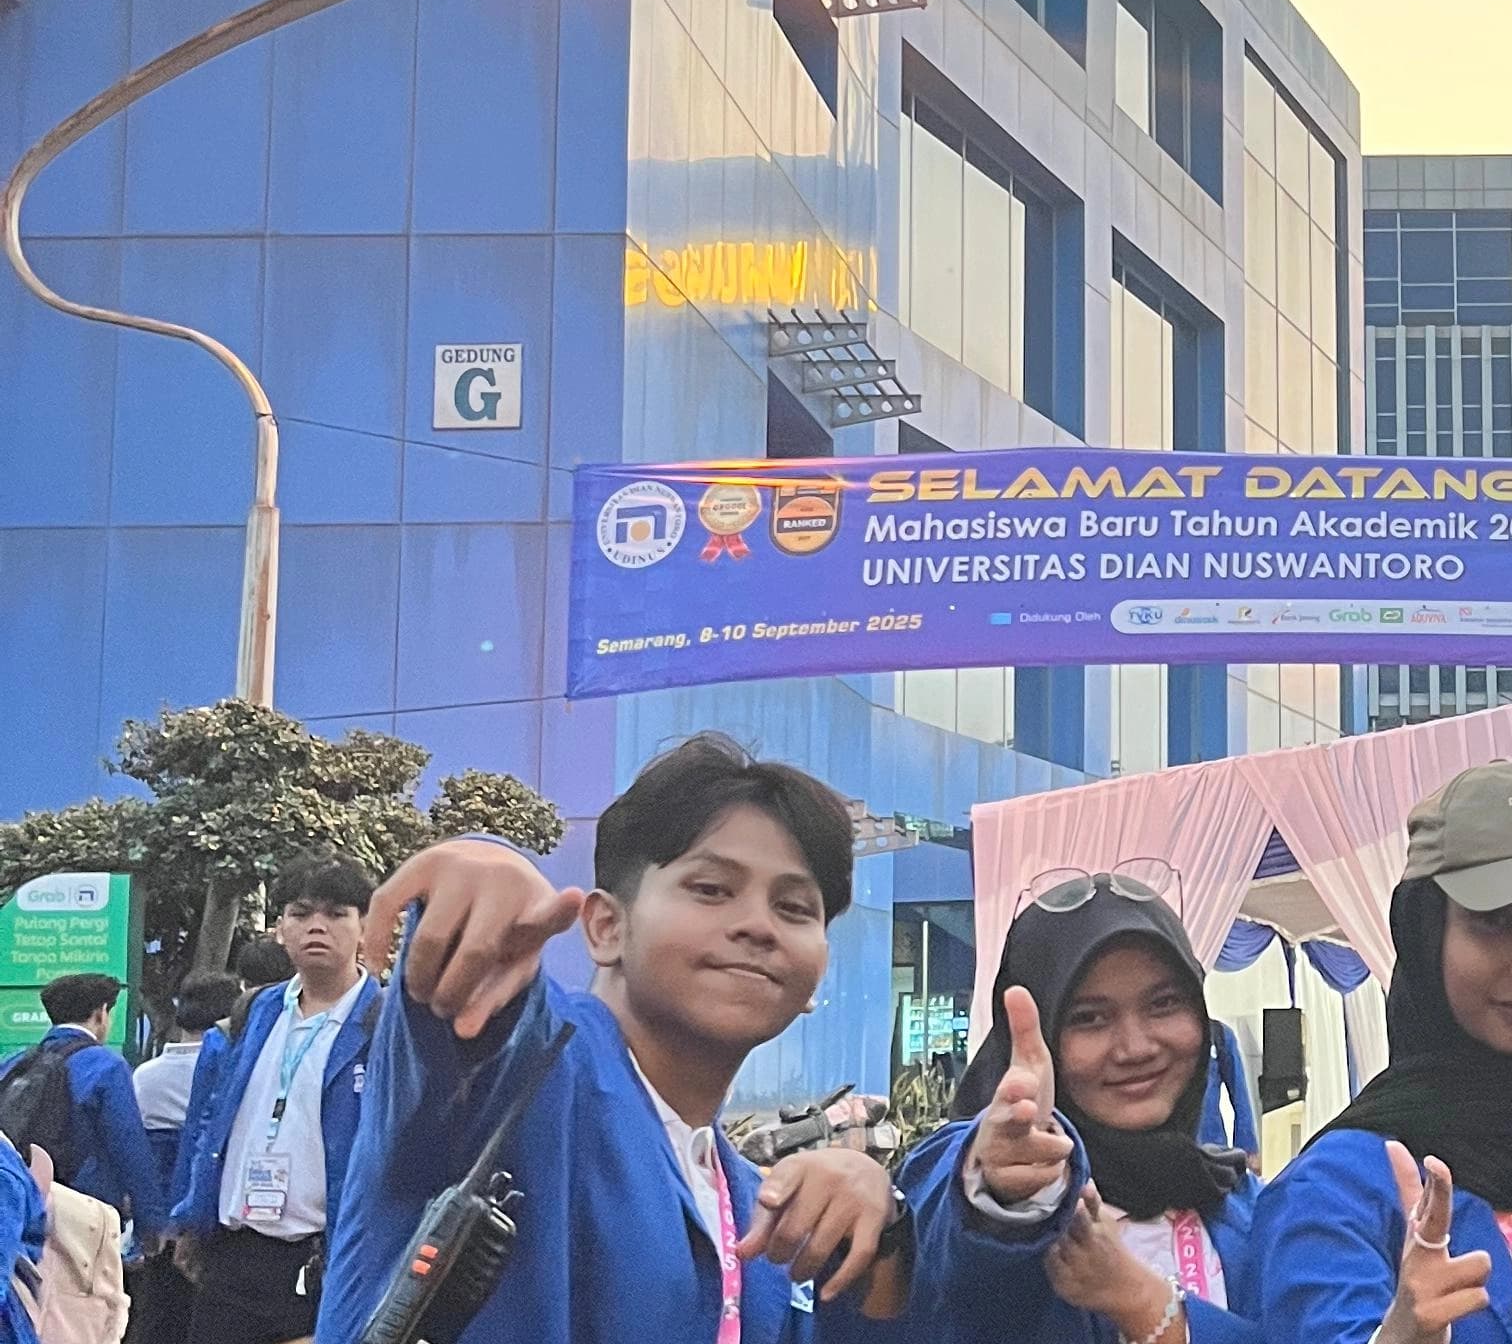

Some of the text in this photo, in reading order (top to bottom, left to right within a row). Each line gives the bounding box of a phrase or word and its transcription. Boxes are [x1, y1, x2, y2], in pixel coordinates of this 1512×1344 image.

[441, 347, 515, 364] GEDUNG
[454, 367, 502, 421] G
[866, 466, 1223, 503] SELAMAT
[783, 518, 826, 529] RANKED
[864, 510, 1067, 543] Mahasiswa
[1079, 510, 1158, 538] Baru
[1170, 510, 1277, 537] Tahun
[1290, 510, 1478, 540] Akademik
[862, 552, 1465, 586] UNIVERSITAS DIAN NUSWANTORO
[1019, 611, 1101, 624] Didukung Oleh
[1328, 608, 1373, 623] Grab
[596, 613, 924, 655] Semarang, 8-10 September 2025
[28, 890, 65, 902] Grab
[14, 916, 109, 932] Pulang Pergi
[60, 933, 107, 946] Santai
